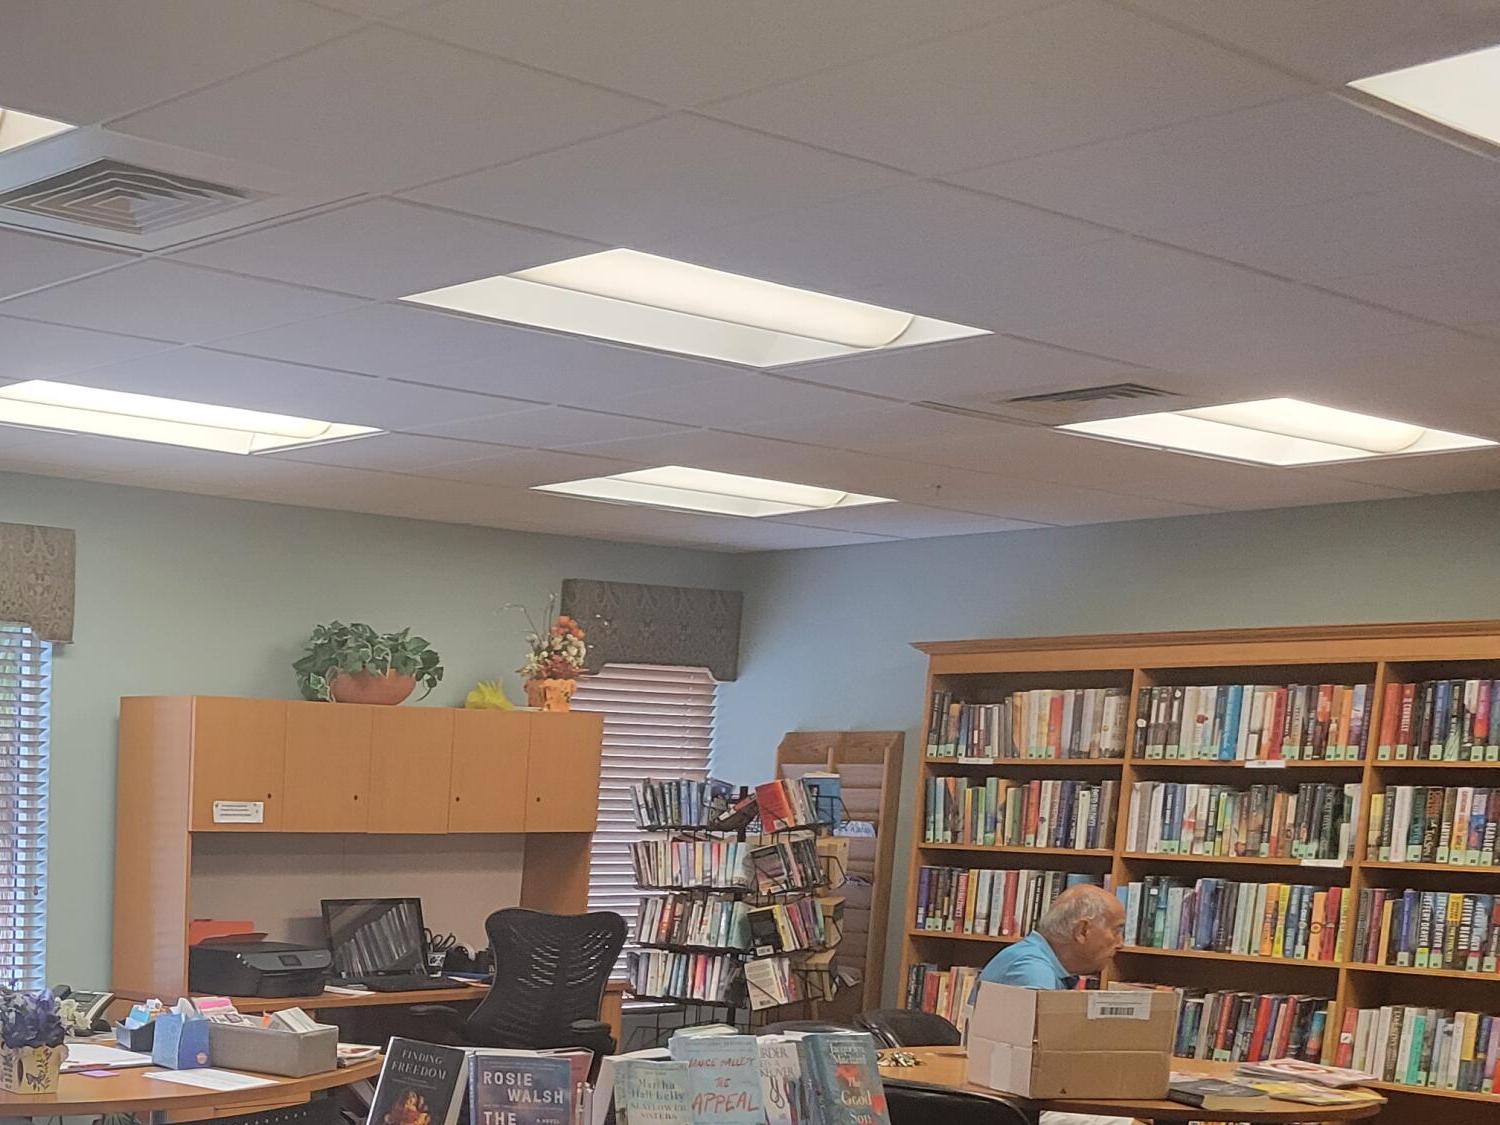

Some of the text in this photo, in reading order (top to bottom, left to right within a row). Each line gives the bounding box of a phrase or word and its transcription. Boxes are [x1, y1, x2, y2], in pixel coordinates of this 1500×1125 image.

[1482, 822, 1498, 852] DEADLOC
[402, 1049, 443, 1065] FINDING
[761, 1047, 788, 1059] RDER
[391, 1061, 447, 1080] FREEDOM
[483, 1071, 533, 1087] ROSIE
[638, 1078, 676, 1089] Martha
[507, 1088, 564, 1104] WALSH
[656, 1090, 684, 1102] Kelly
[691, 1091, 760, 1117] APPEAL
[841, 1089, 873, 1106] Good
[850, 1110, 873, 1124] Son
